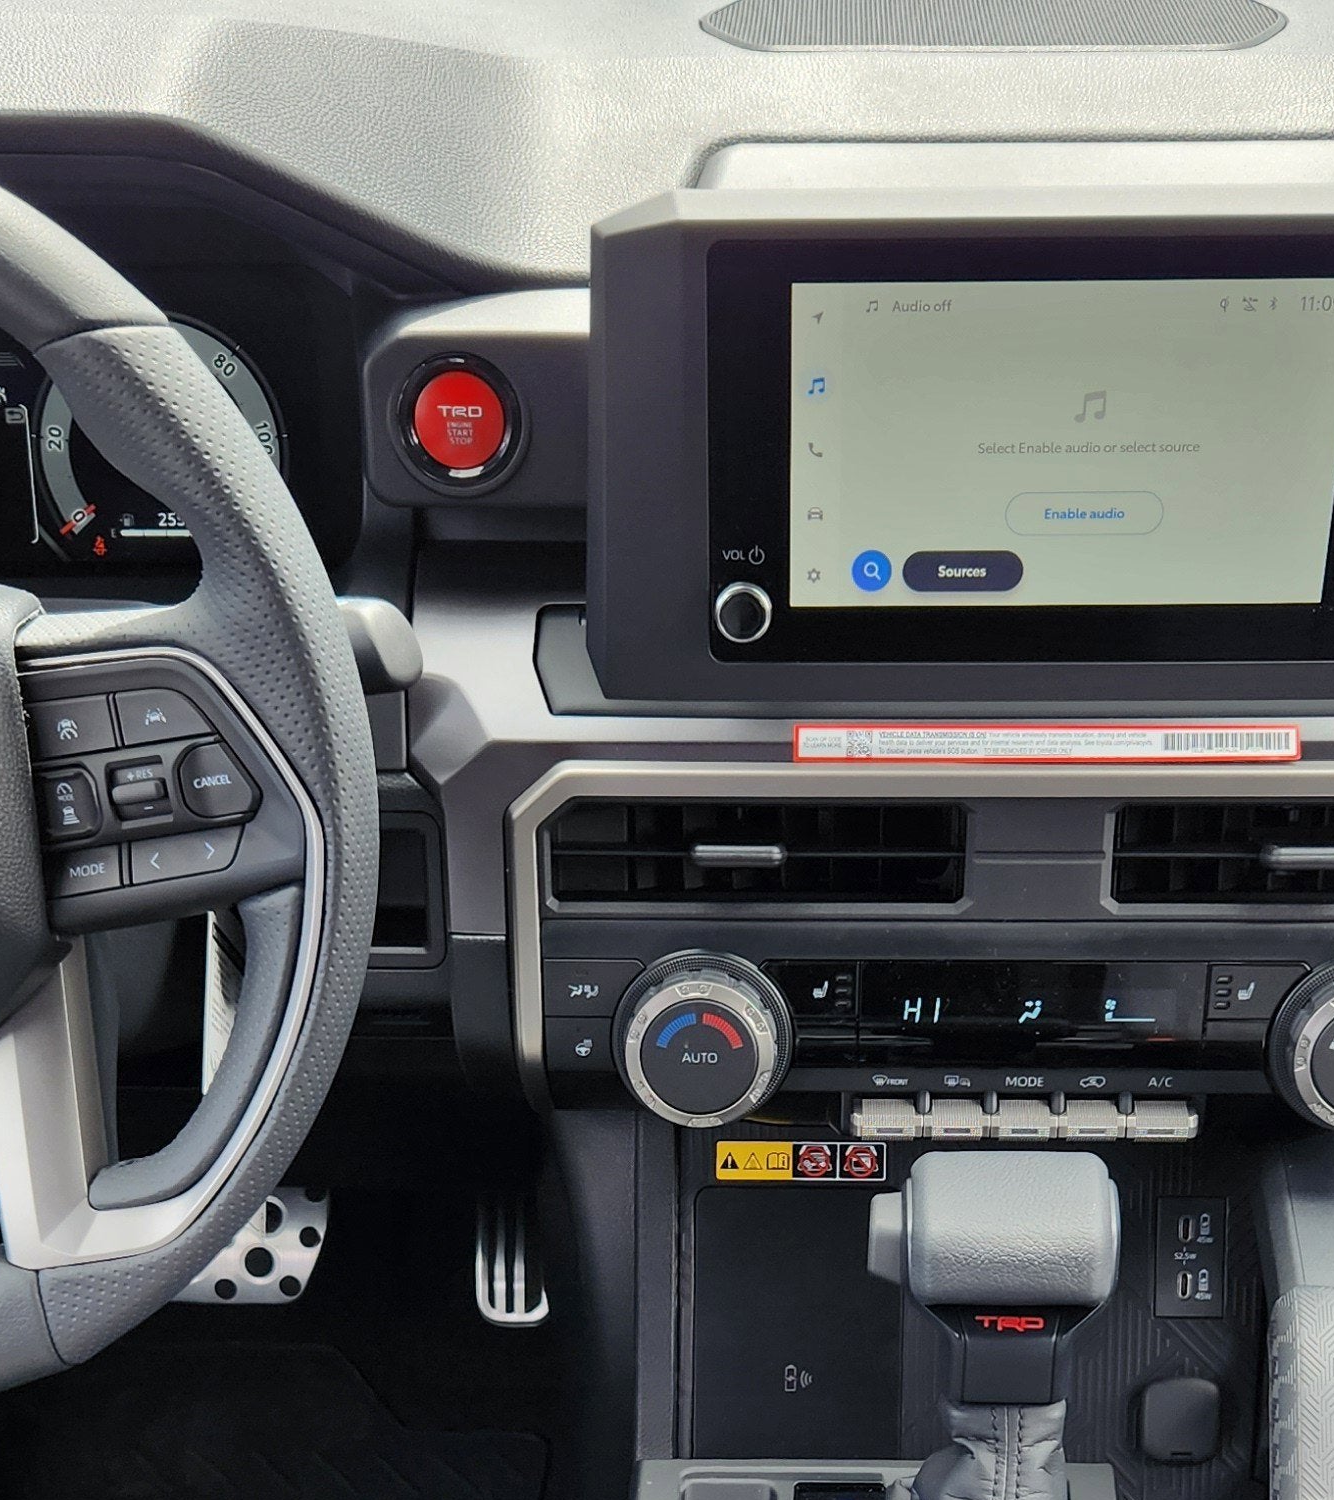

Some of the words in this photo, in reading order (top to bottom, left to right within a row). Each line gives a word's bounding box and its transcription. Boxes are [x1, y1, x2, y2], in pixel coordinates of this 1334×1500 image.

[892, 300, 931, 313] Audio
[933, 299, 952, 312] off
[212, 352, 236, 378] 80
[436, 405, 484, 418] TRD
[446, 421, 473, 429] ENGINE
[47, 426, 64, 451] 20
[446, 429, 474, 437] START
[449, 436, 473, 445] STOP
[978, 442, 1016, 455] Select
[1018, 442, 1062, 454] Enable
[1065, 441, 1101, 454] audio
[1103, 444, 1118, 454] or
[1120, 440, 1156, 453] select
[1159, 442, 1201, 453] source
[1044, 508, 1087, 520] Enable
[1089, 508, 1126, 520] audio
[722, 549, 746, 561] VOL
[937, 564, 987, 579] Sources
[192, 774, 233, 789] CANCEL
[69, 861, 106, 879] MODE
[681, 1053, 718, 1065] AUTO
[885, 1077, 909, 1087] FRONT
[1004, 1075, 1045, 1088] MODE
[1147, 1075, 1174, 1089] A/C
[974, 1315, 1045, 1332] TRD
